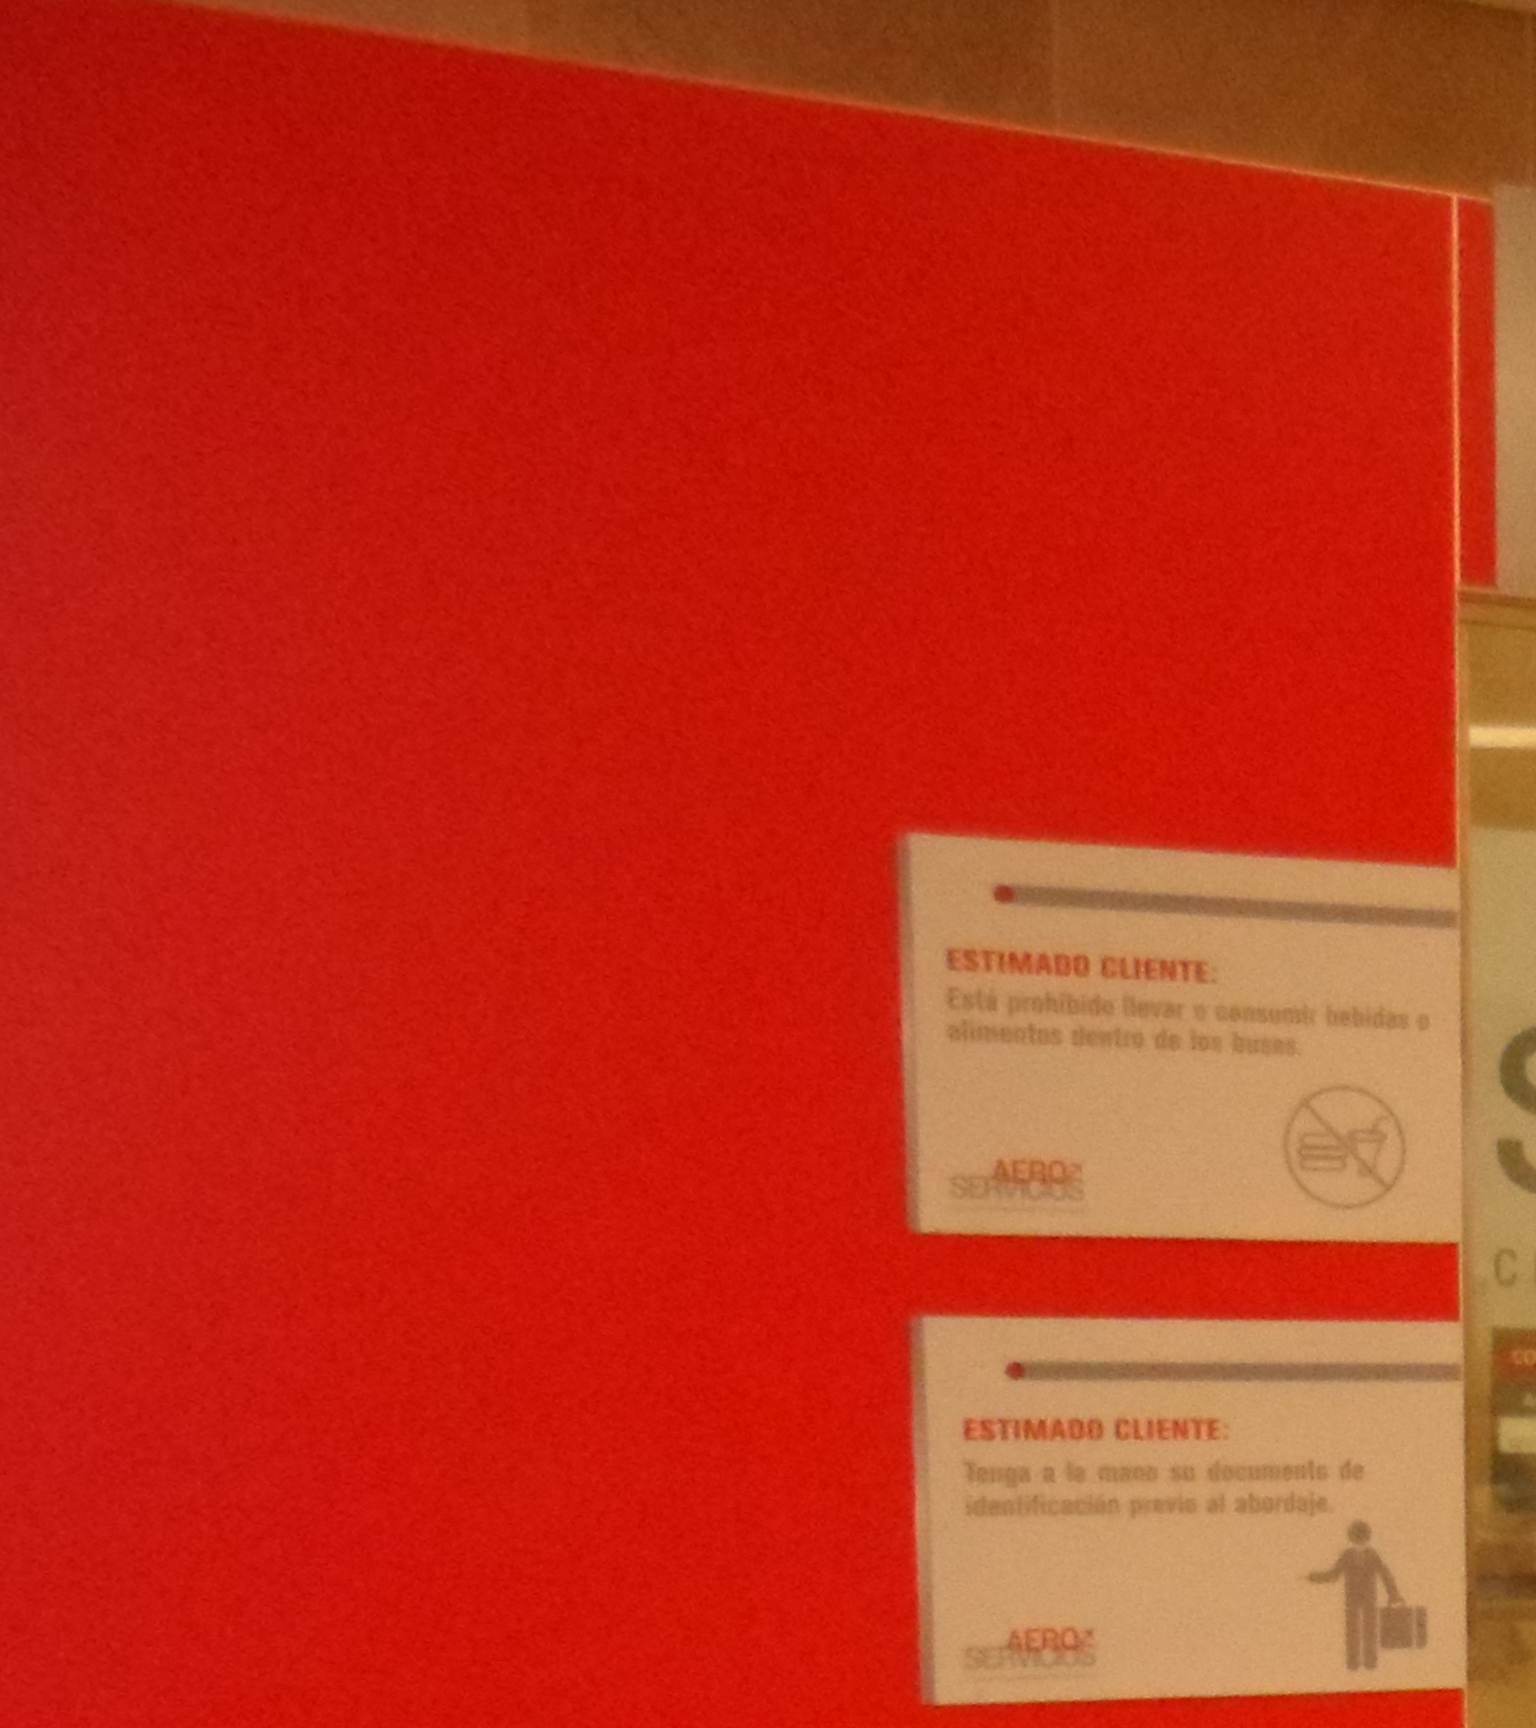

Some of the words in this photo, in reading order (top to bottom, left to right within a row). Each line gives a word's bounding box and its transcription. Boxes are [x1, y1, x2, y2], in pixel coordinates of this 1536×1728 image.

[946, 948, 1091, 979] ESTIMADO
[1100, 955, 1216, 985] CLIENTE:
[992, 1158, 1068, 1186] AERO
[963, 1417, 1104, 1442] ESTIMADO
[1114, 1417, 1229, 1442] CLIENTE:
[964, 1460, 1032, 1488] Tenga
[1043, 1466, 1056, 1483] a
[1098, 1465, 1158, 1483] mano
[1206, 1460, 1329, 1482] documento
[1339, 1458, 1366, 1480] de
[1129, 1496, 1198, 1518] previo
[1007, 1627, 1080, 1652] AERO
